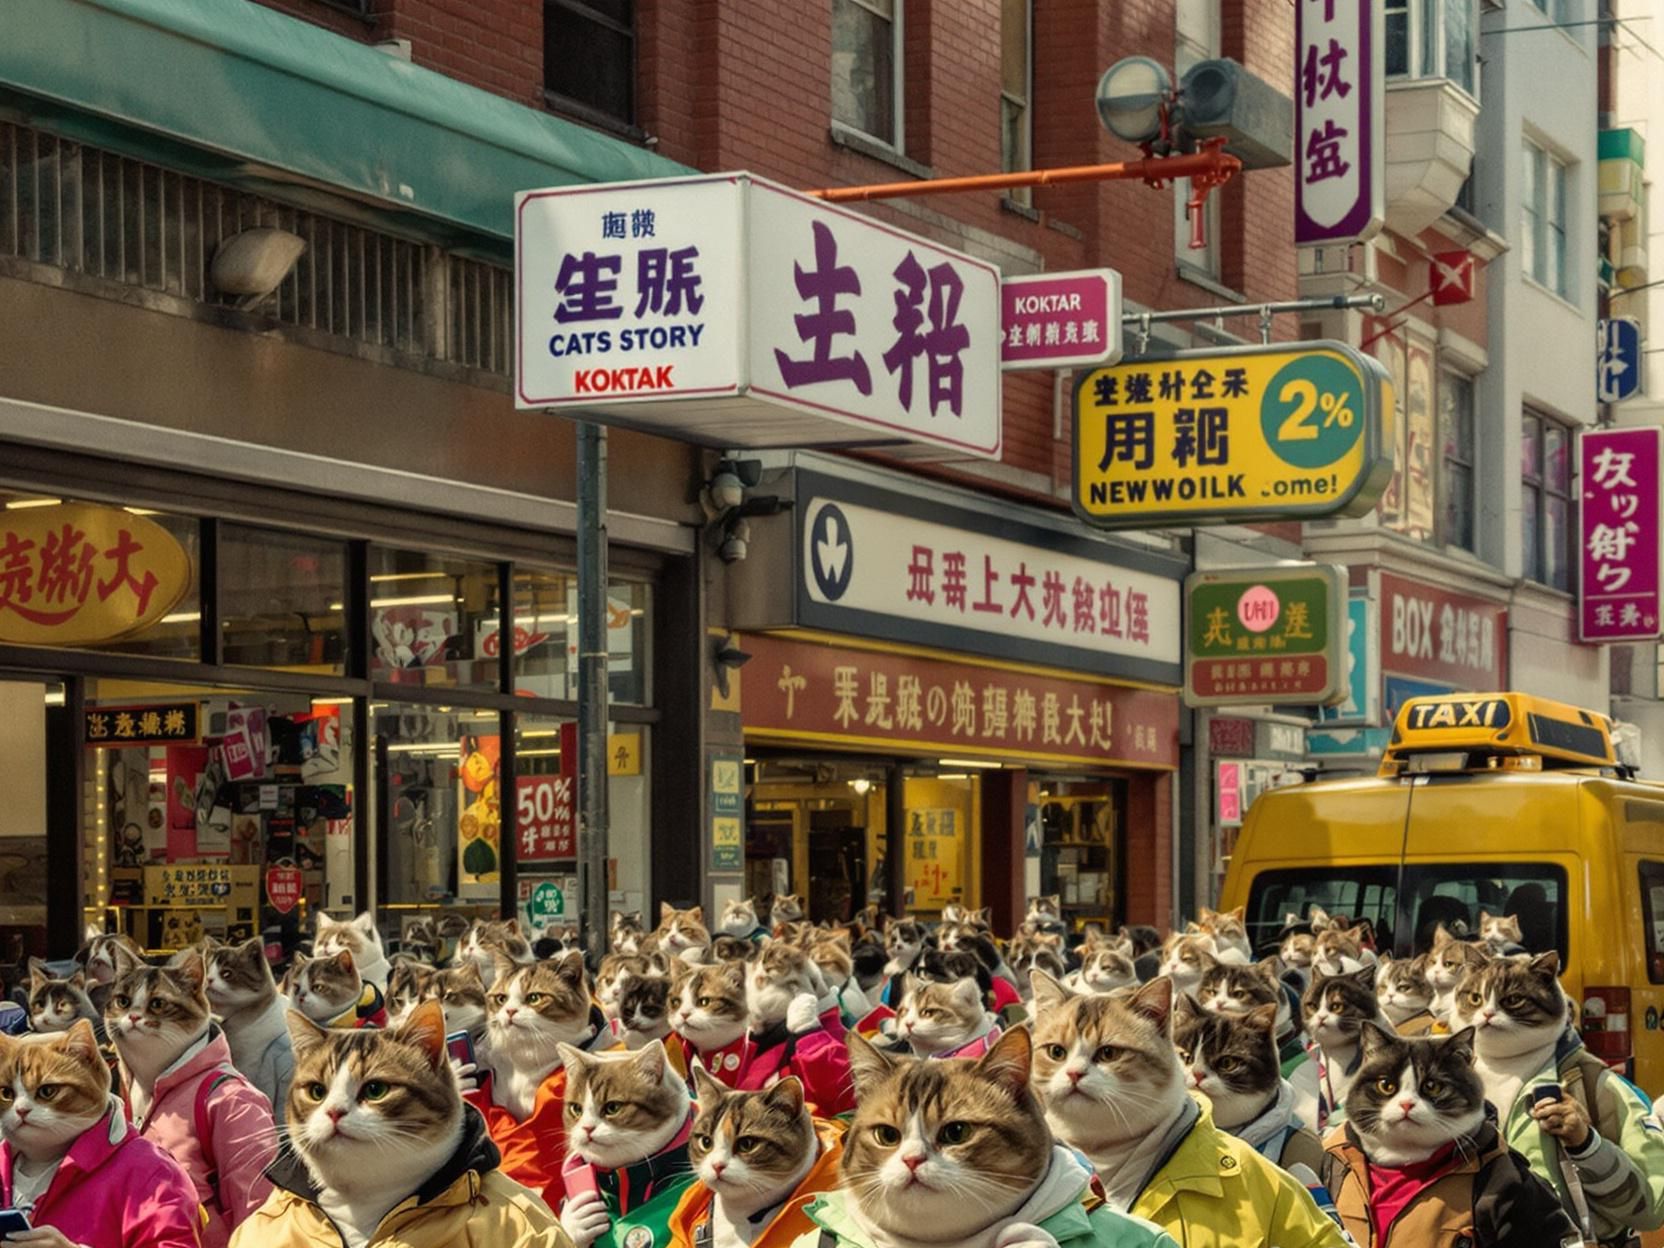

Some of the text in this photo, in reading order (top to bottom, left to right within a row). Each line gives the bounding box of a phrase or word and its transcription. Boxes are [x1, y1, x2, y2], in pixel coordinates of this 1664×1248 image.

[1014, 293, 1082, 315] KOKTAR
[549, 324, 704, 357] CATS STORY
[574, 366, 675, 394] KOKTAK
[1277, 379, 1353, 441] 2%
[1392, 594, 1433, 660] BOX
[1414, 701, 1498, 727] TAXI
